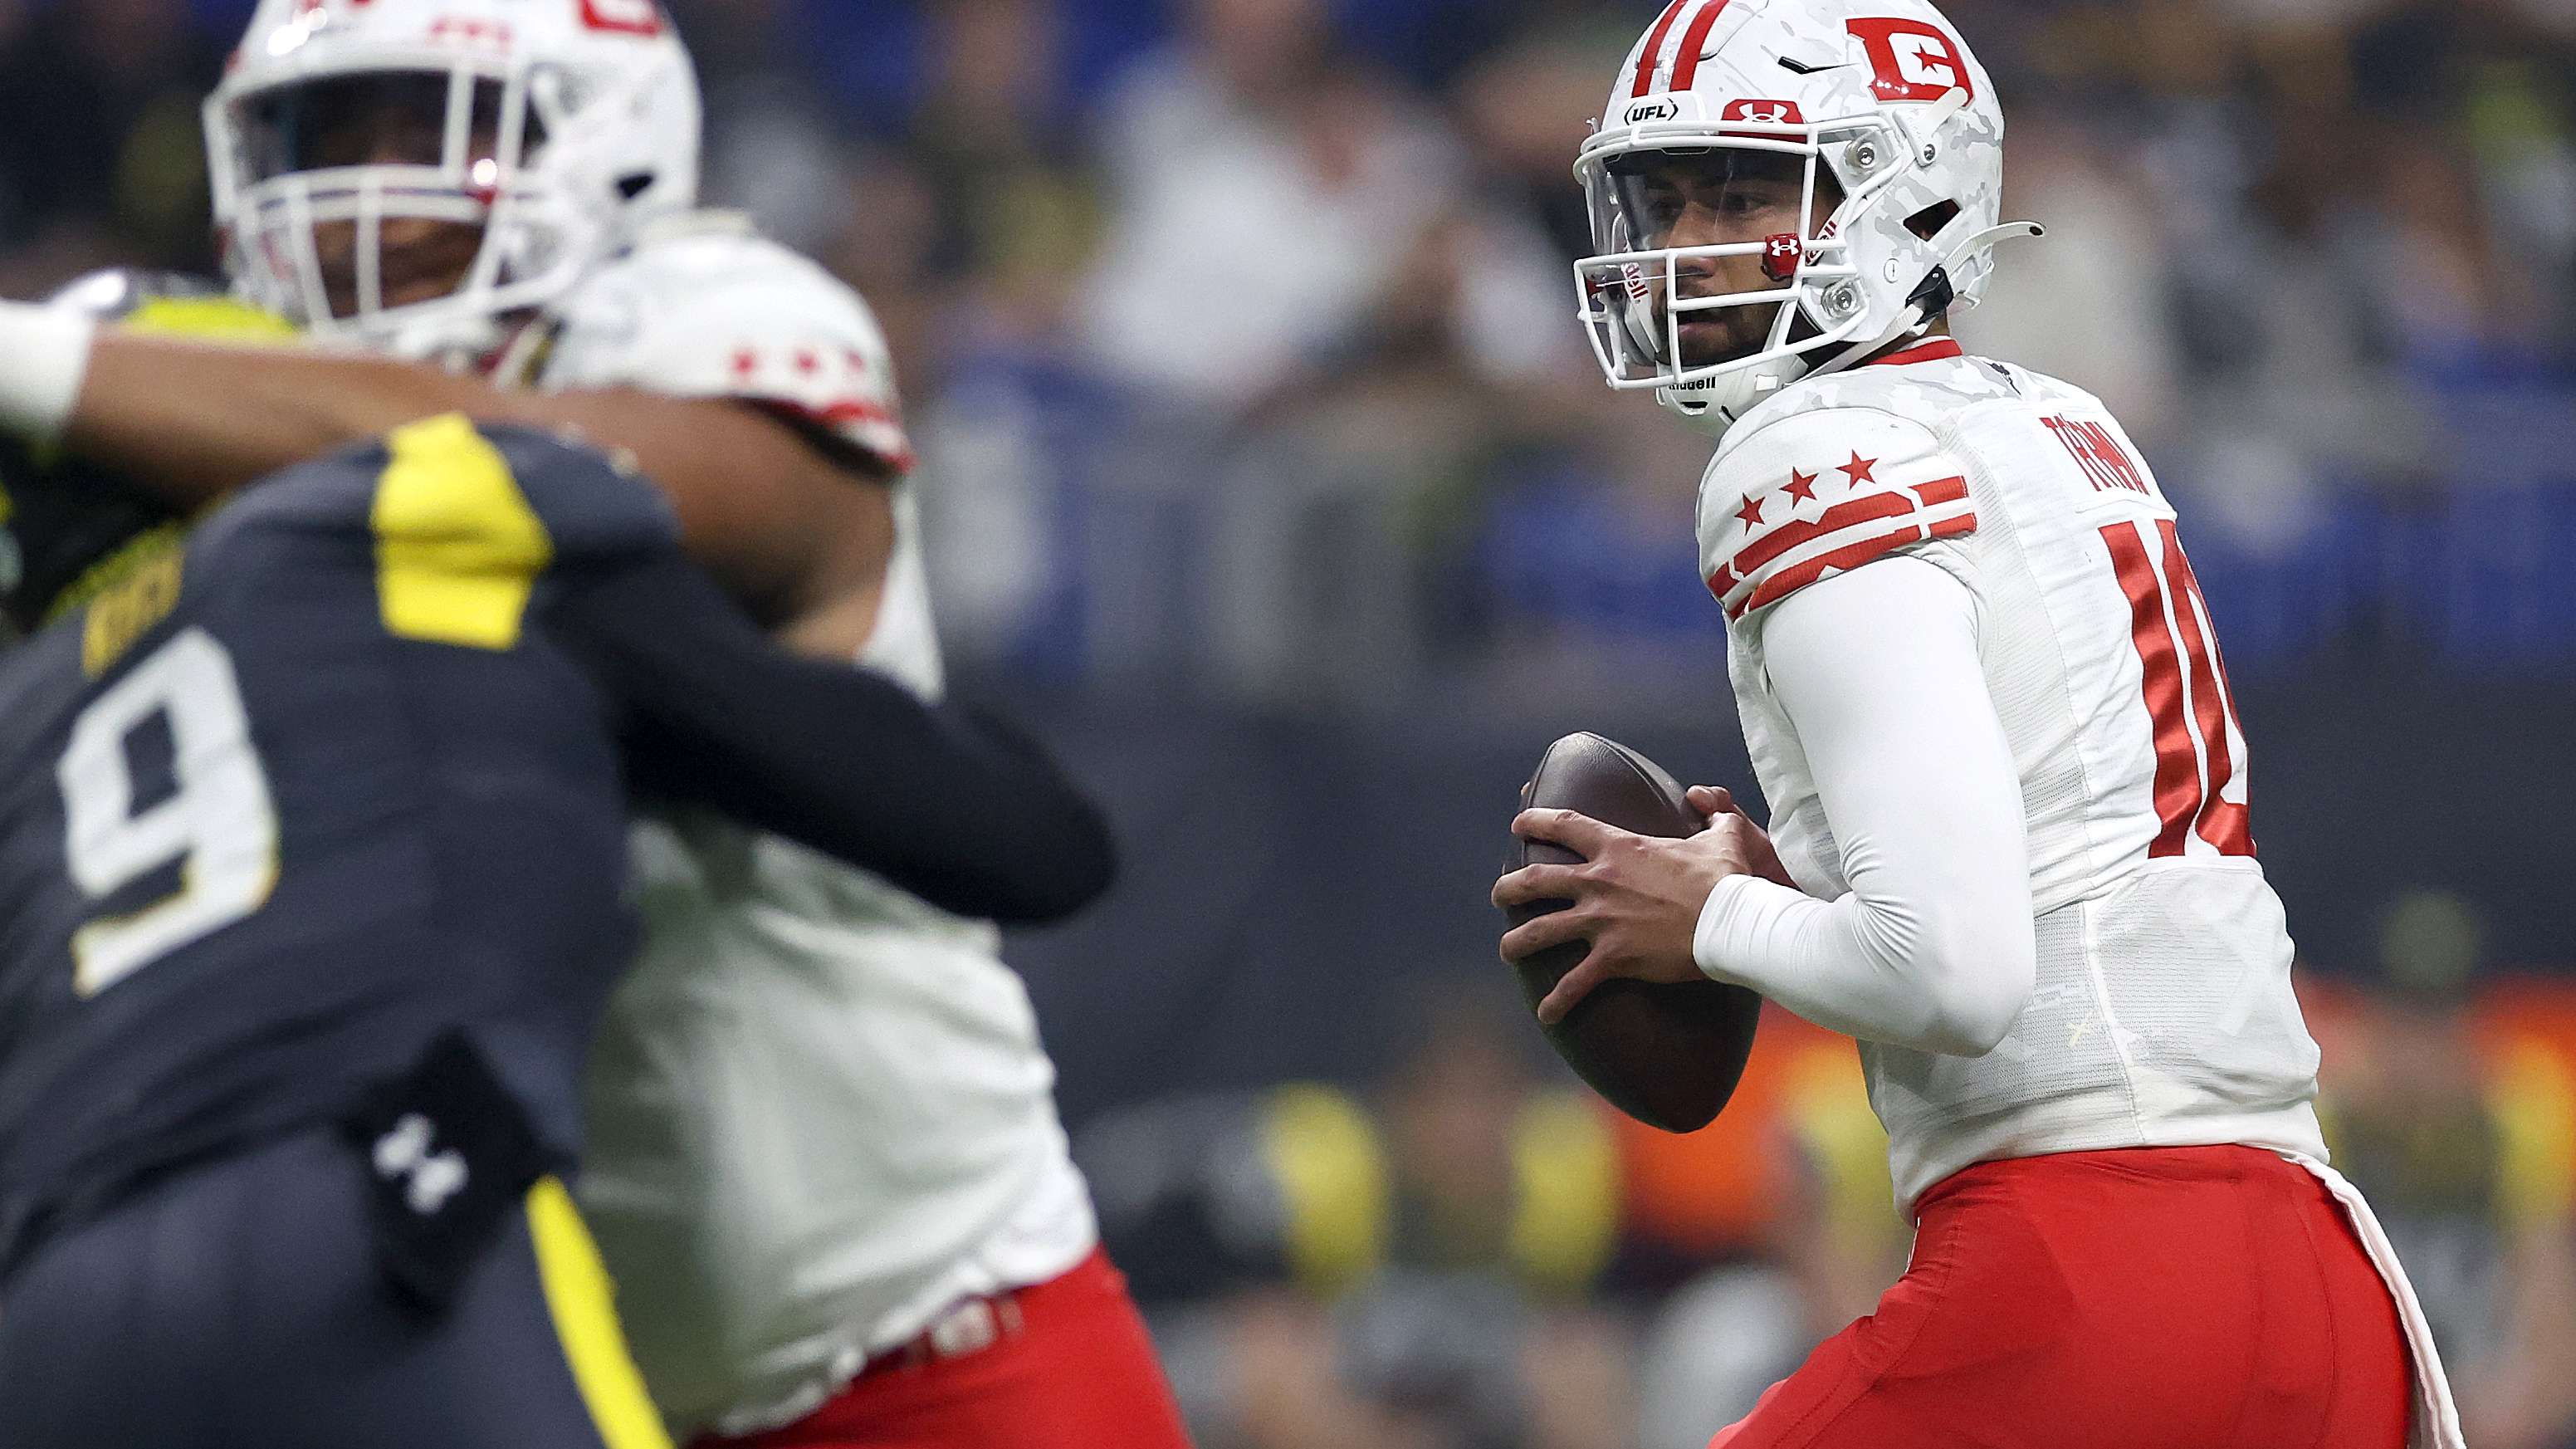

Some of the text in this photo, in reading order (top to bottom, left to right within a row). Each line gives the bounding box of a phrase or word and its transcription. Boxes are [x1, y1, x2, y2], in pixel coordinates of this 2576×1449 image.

[1631, 105, 1668, 122] UFL
[56, 625, 281, 999] 9
[2098, 518, 2257, 857] 10
